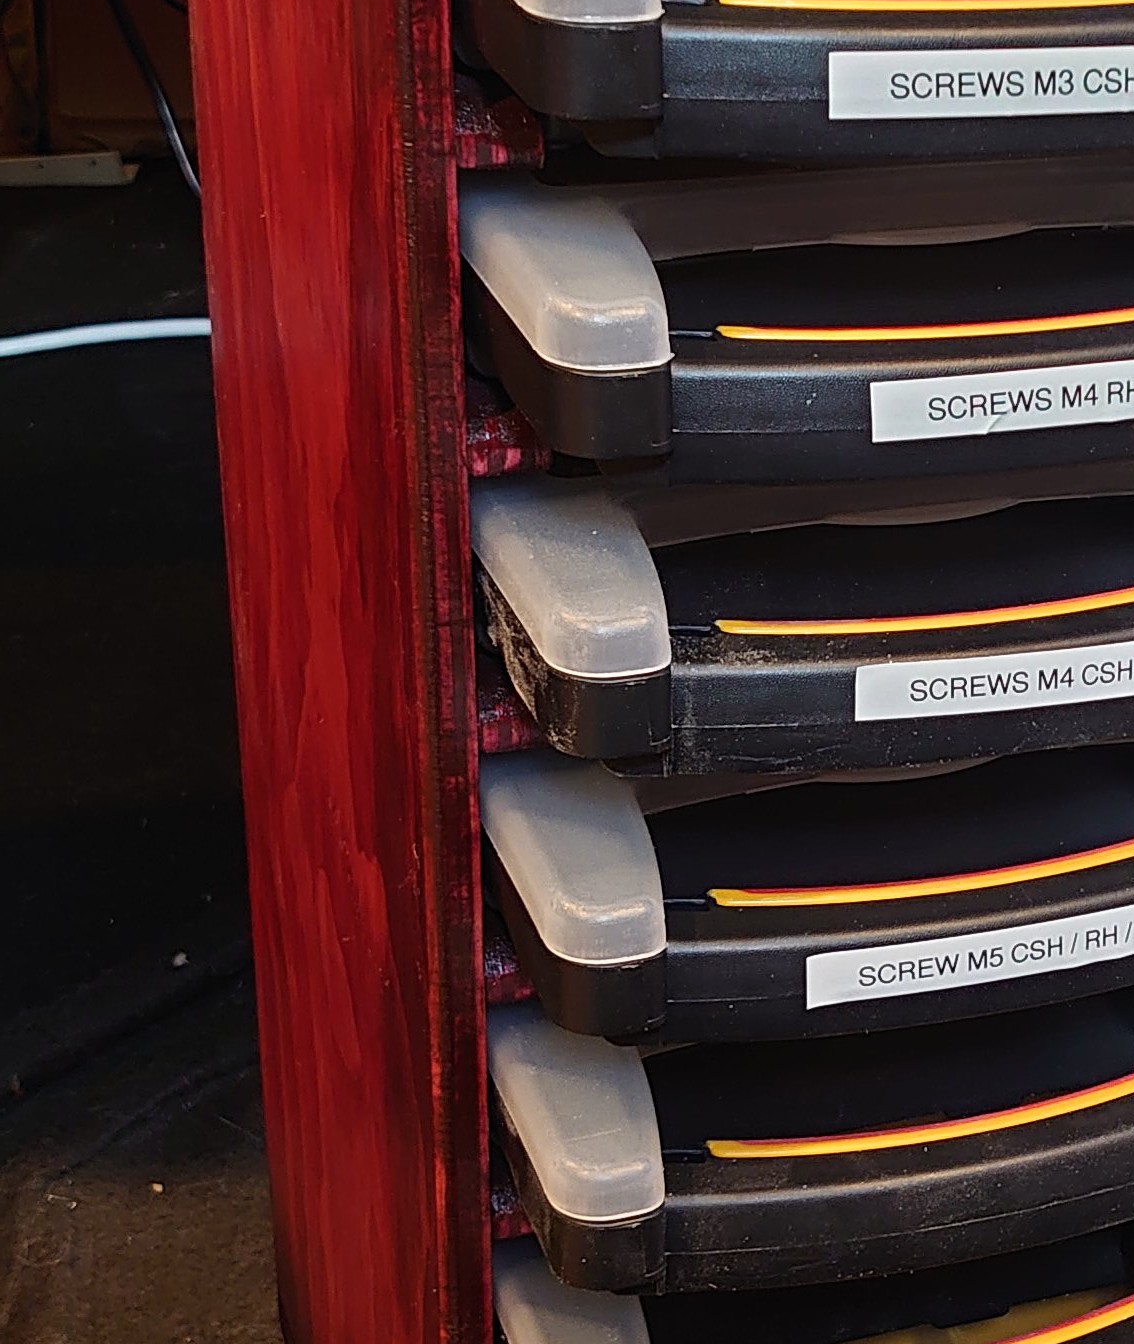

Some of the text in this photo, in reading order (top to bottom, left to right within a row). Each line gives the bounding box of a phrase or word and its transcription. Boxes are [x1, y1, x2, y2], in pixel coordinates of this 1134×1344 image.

[890, 70, 1025, 100] SCREWS
[1034, 68, 1075, 97] M3
[928, 387, 1053, 422] SCREWS
[1061, 383, 1099, 409] M4
[909, 658, 1133, 702] SCREWS M4 CSH
[858, 953, 960, 987] SCREW
[967, 946, 1004, 972] M5
[1010, 935, 1063, 964] CSH
[1070, 932, 1079, 955] /
[1085, 924, 1118, 951] RH
[1124, 921, 1133, 943] /
